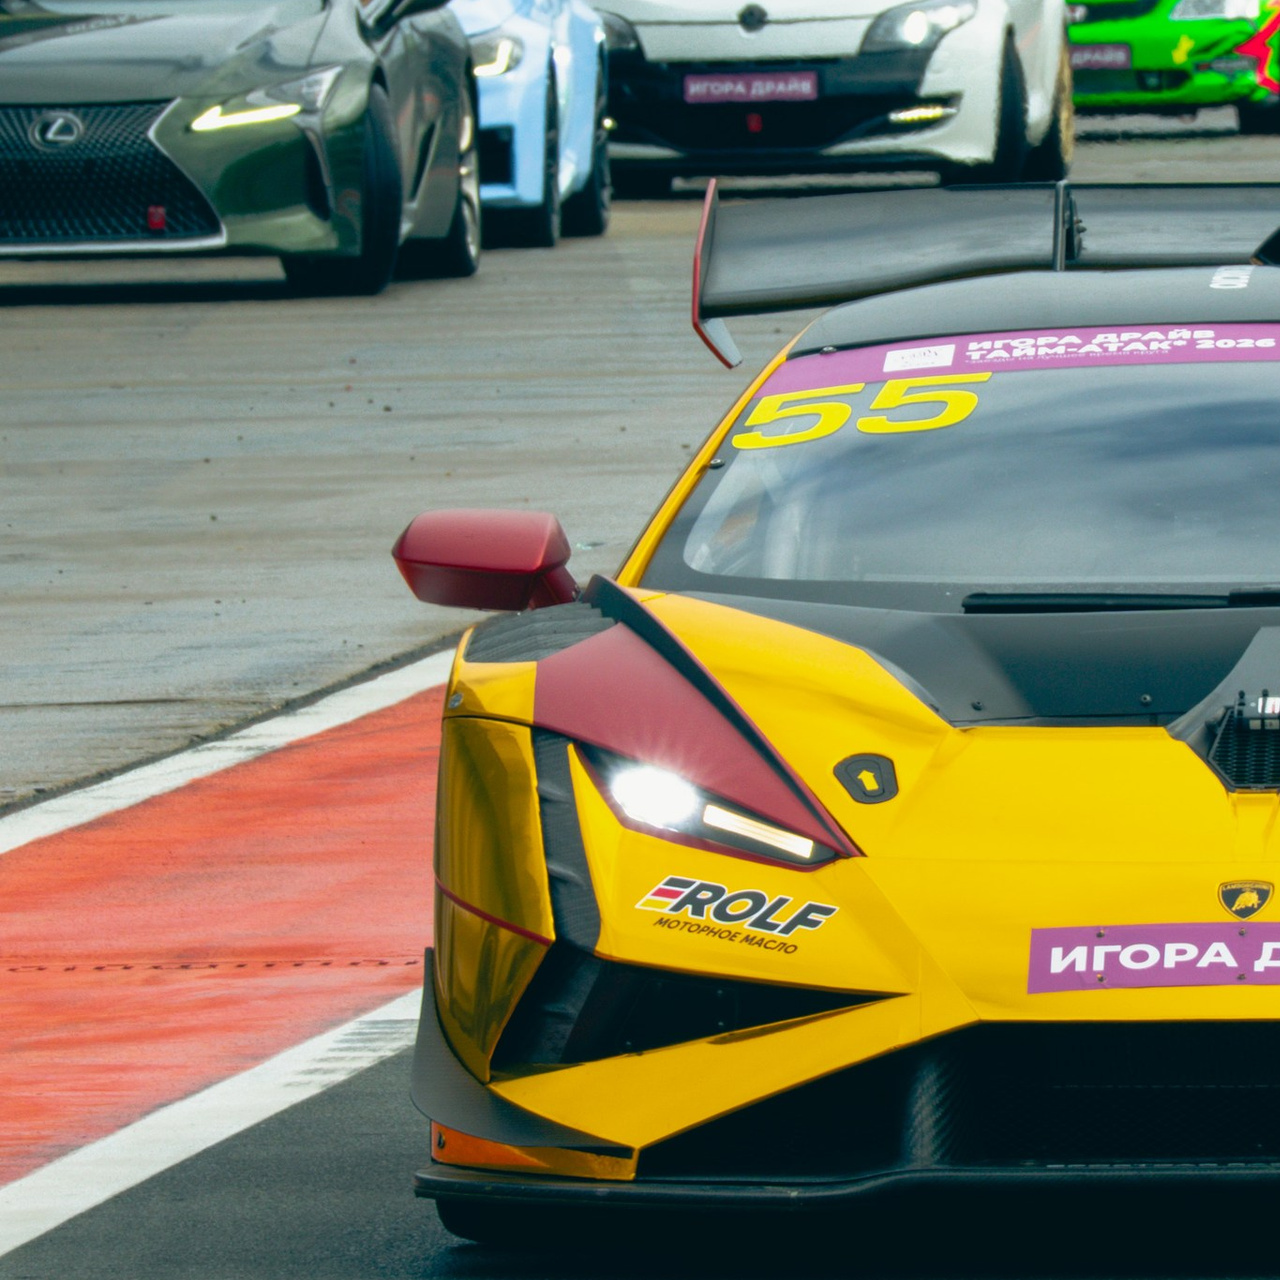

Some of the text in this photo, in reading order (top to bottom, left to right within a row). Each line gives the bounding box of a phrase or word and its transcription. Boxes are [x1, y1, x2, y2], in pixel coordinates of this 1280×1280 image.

[689, 76, 812, 96] ИГОРА ДРАЙВ
[967, 328, 1215, 352] ИГОРА ДРАЙВ
[1195, 338, 1276, 349] 2026
[731, 371, 993, 450] 55
[669, 879, 840, 937] ROLF
[653, 917, 798, 955] МОТОРНОЕ МАСЛО
[1049, 941, 1238, 974] ИГОРА
